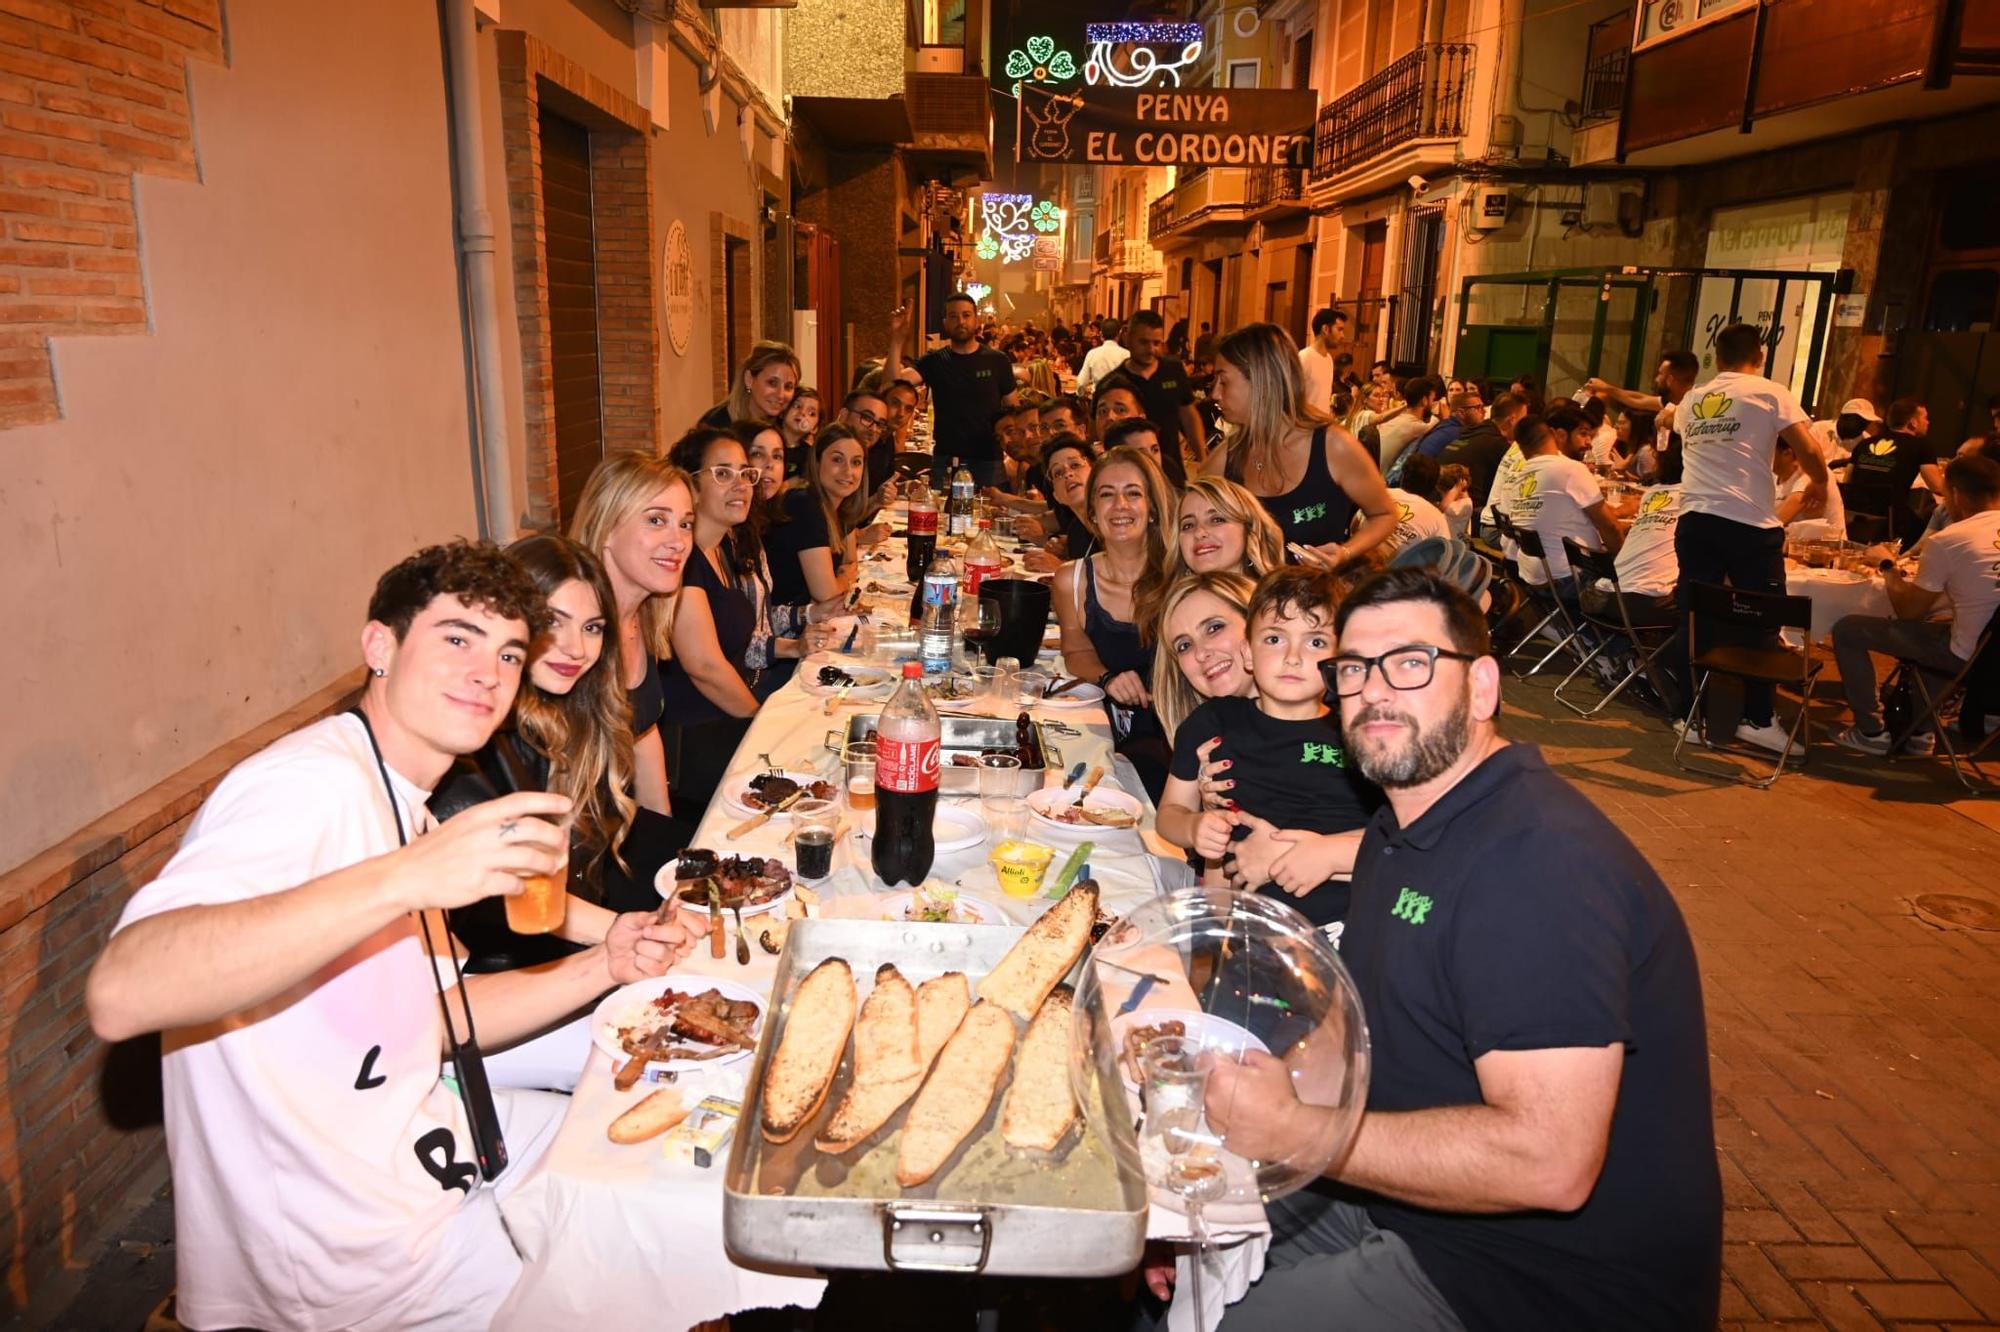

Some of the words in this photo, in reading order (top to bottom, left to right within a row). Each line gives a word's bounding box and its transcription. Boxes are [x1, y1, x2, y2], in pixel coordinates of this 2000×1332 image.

[1136, 94, 1229, 122] PENYA
[1087, 131, 1123, 162] EL
[1135, 133, 1311, 165] CORDONET
